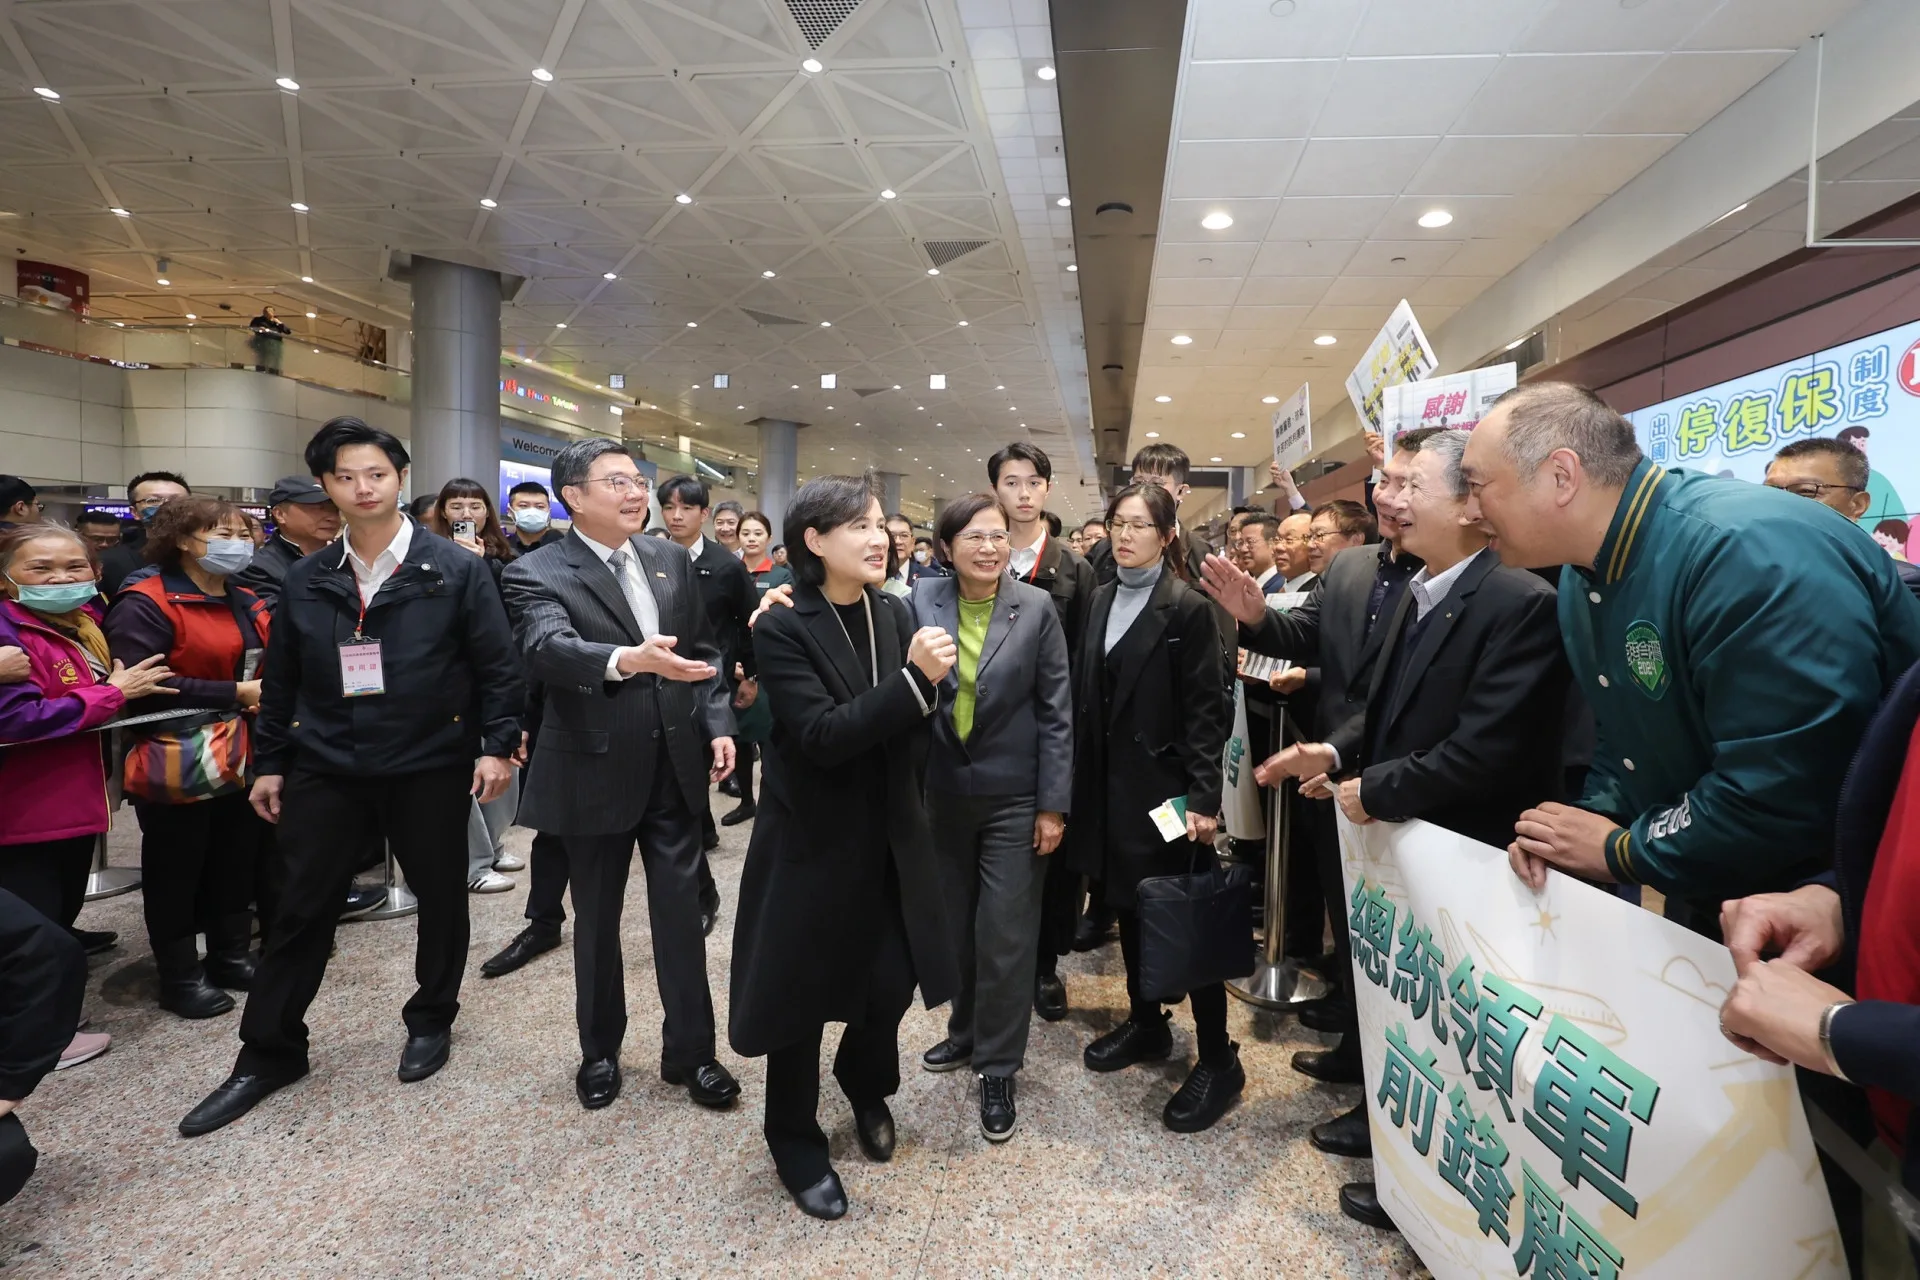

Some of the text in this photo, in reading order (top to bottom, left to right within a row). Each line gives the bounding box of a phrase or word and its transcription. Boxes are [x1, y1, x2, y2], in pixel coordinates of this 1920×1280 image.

[1422, 389, 1467, 420] 感謝
[1676, 369, 1838, 455] 停復保
[1852, 349, 1885, 418] 制度
[1349, 874, 1660, 1219] 總統領軍
